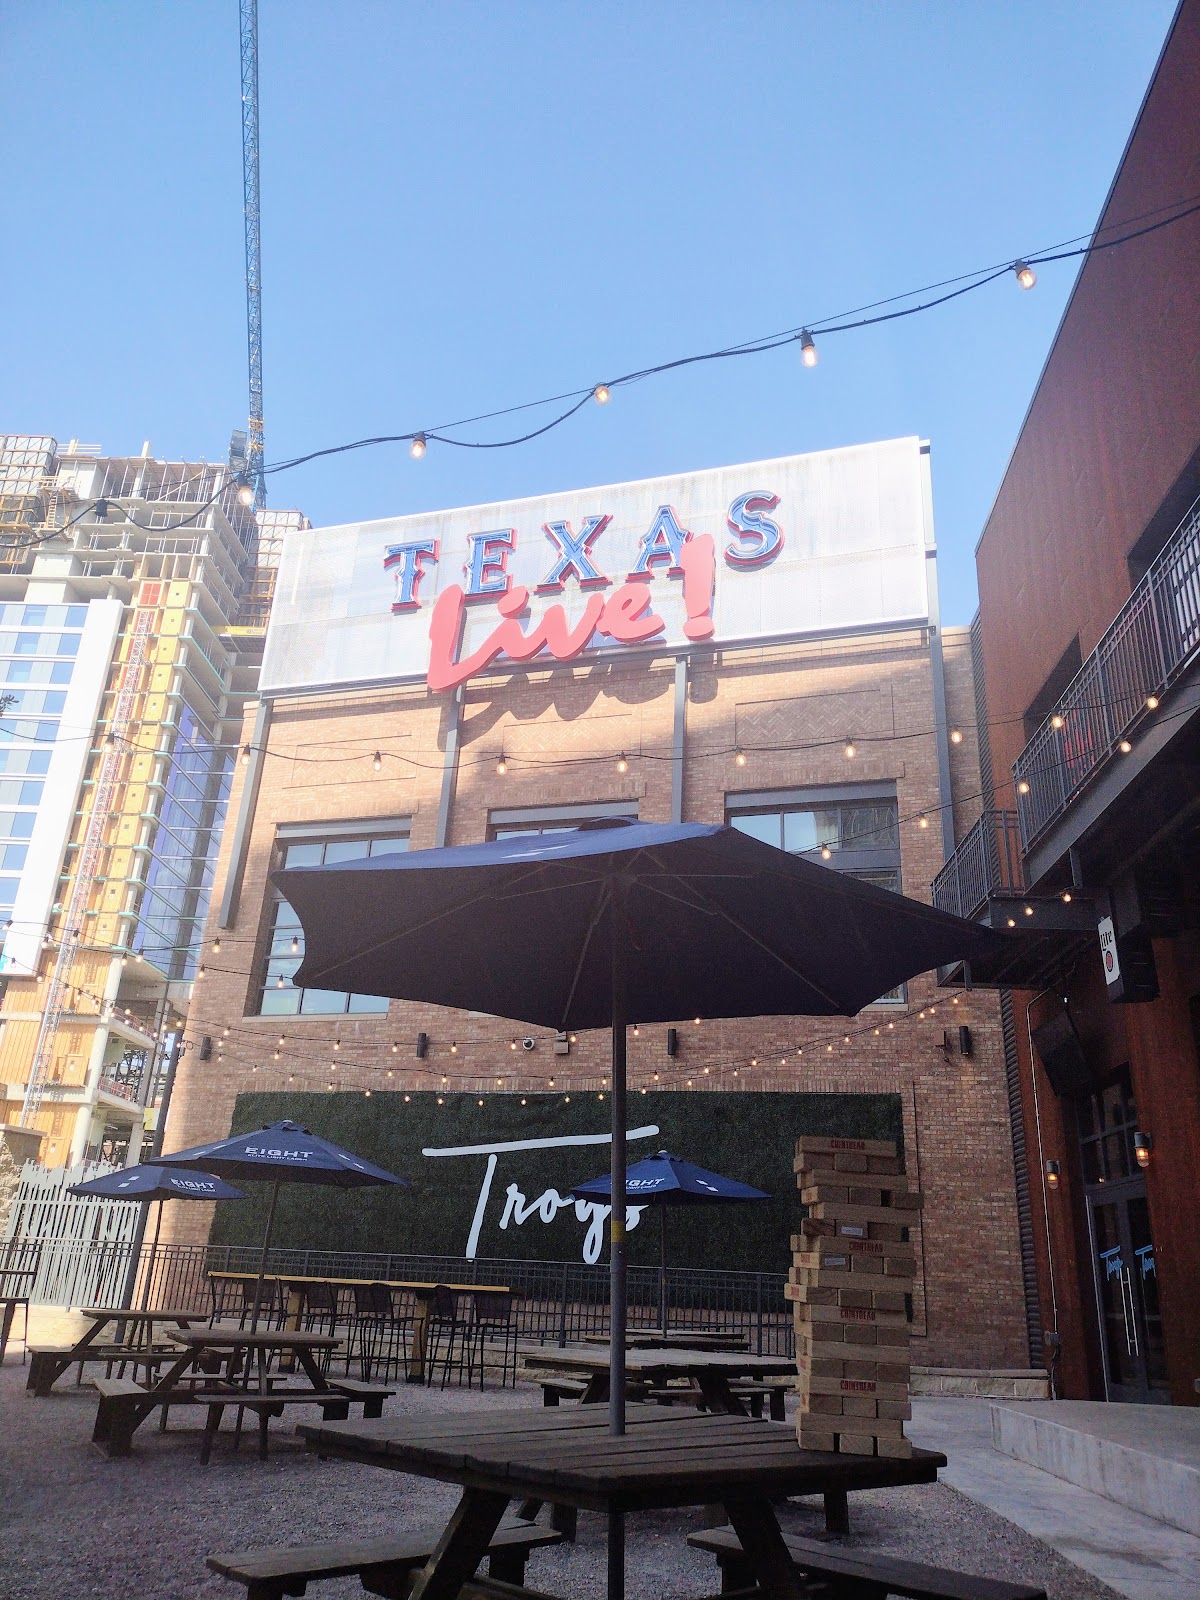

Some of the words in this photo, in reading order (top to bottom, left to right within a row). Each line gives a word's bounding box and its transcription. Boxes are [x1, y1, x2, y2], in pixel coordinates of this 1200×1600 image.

[384, 490, 785, 610] TEXAS
[427, 534, 715, 692] Live!
[170, 1178, 214, 1189] EIGHT
[245, 1146, 313, 1158] EIGHT
